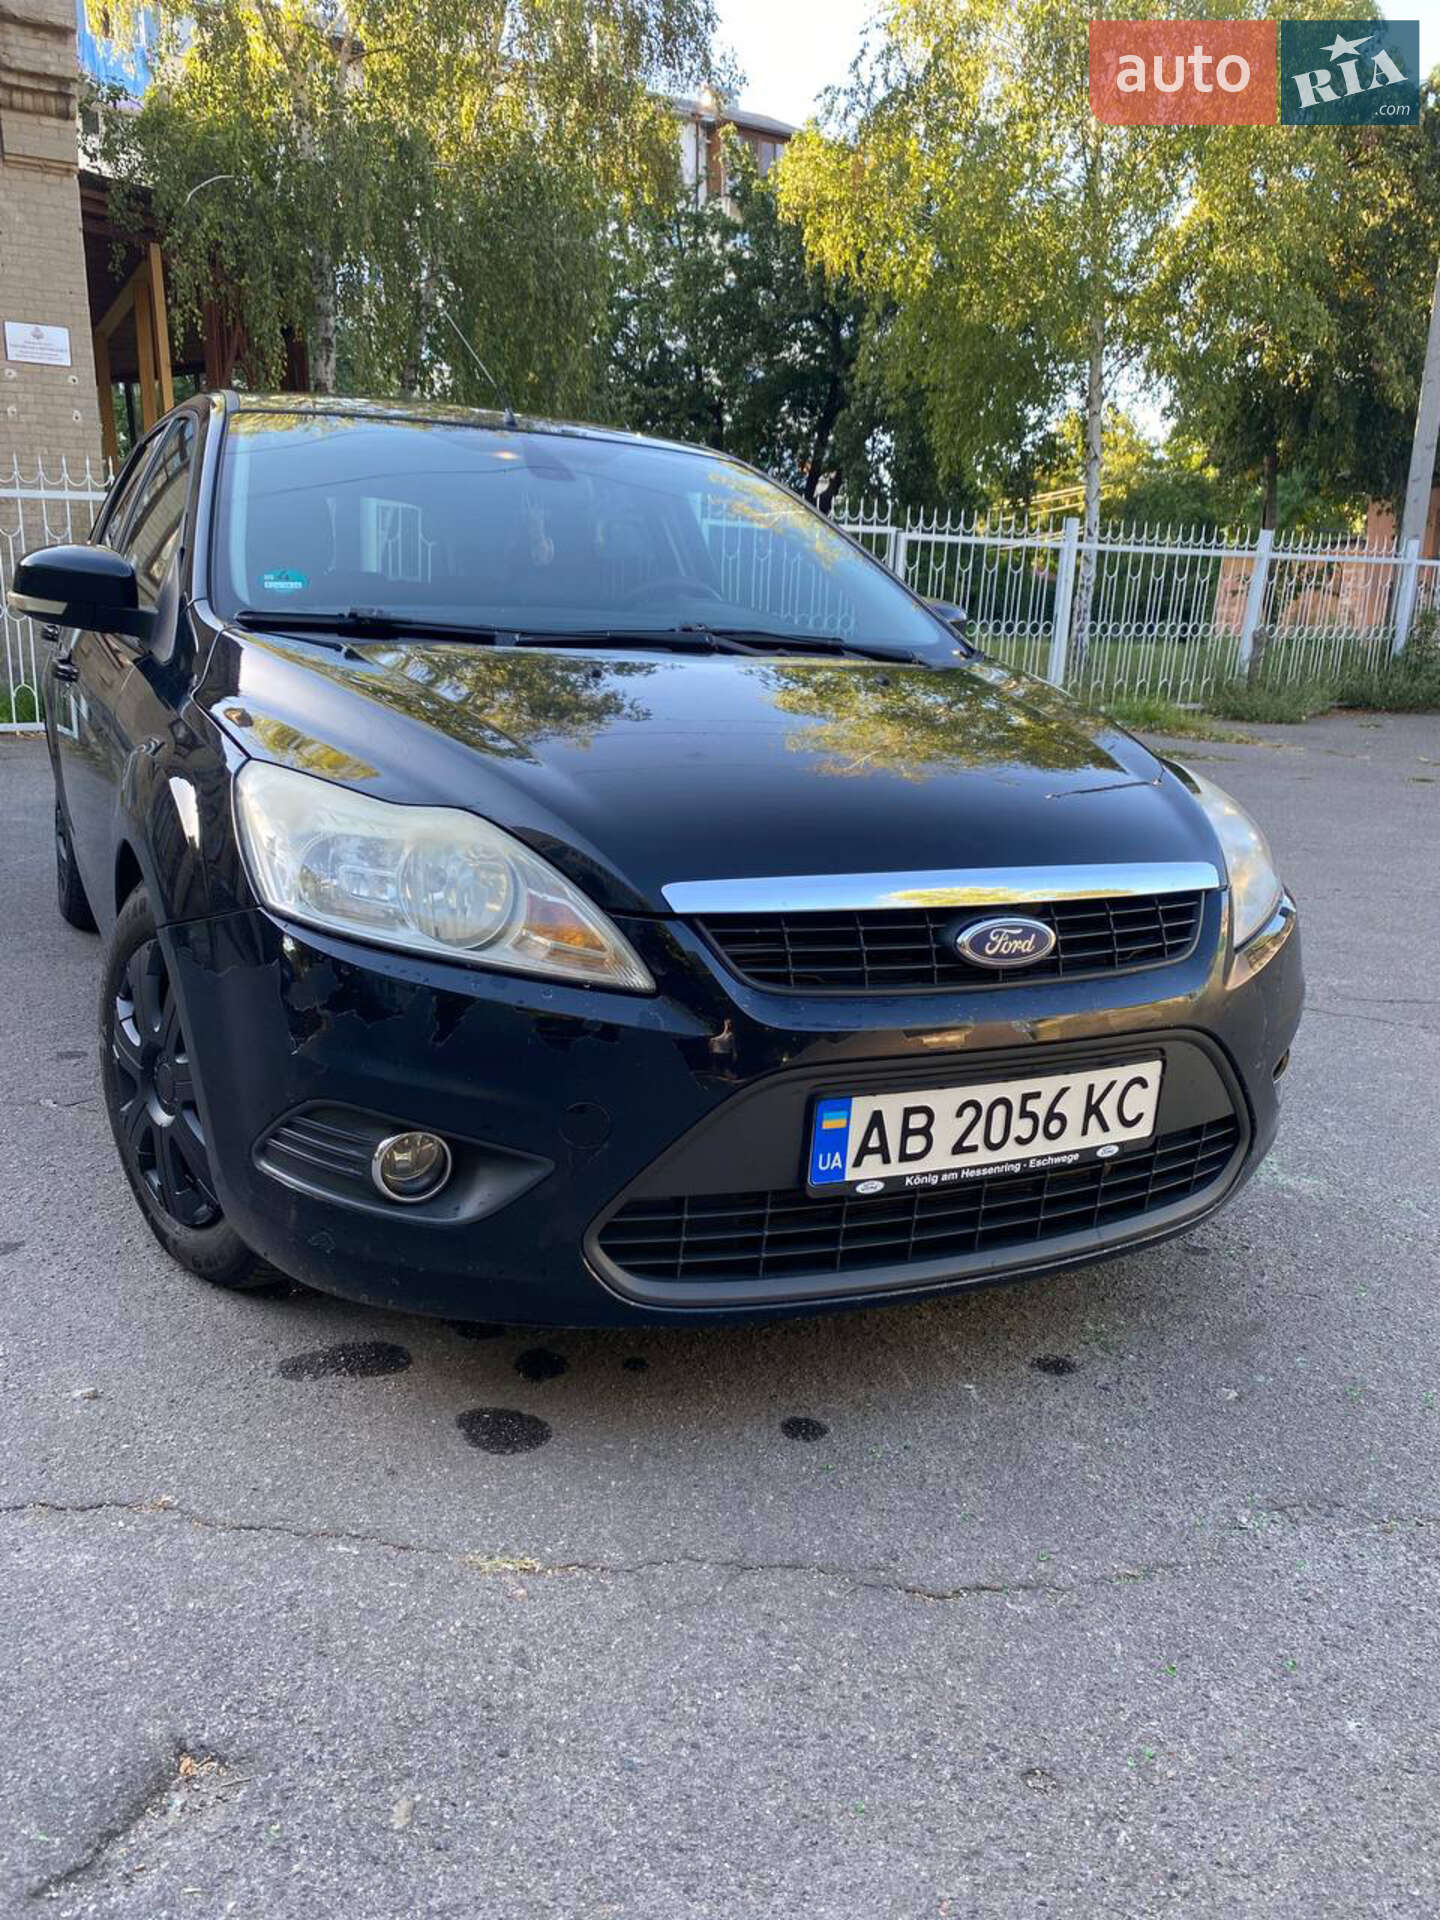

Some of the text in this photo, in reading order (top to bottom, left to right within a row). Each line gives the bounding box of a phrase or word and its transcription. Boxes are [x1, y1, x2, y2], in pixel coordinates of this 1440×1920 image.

[984, 928, 1036, 955] Ford
[852, 1076, 1149, 1168] AB 2056 KC
[818, 1151, 843, 1170] UA
[905, 1172, 939, 1187] König
[941, 1171, 958, 1182] am
[961, 1161, 1021, 1179] Hessenring
[1028, 1152, 1080, 1168] Eschwege
